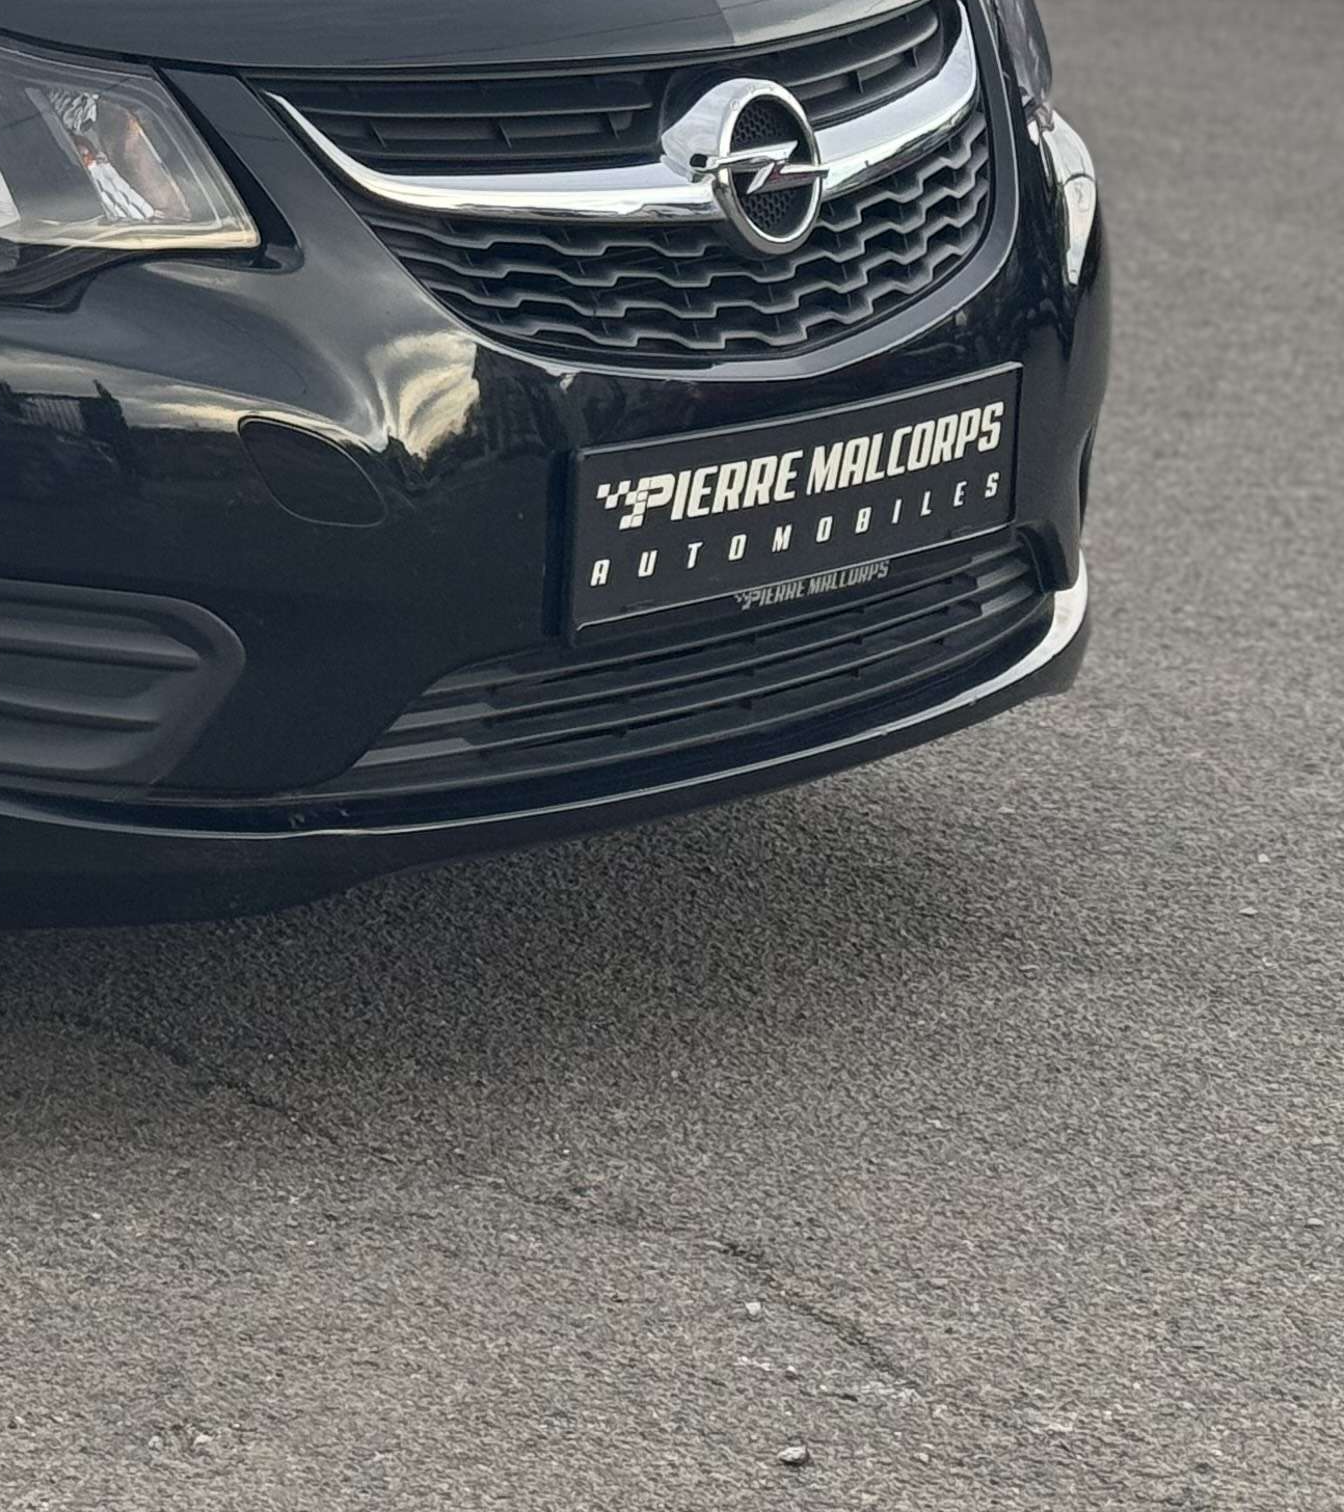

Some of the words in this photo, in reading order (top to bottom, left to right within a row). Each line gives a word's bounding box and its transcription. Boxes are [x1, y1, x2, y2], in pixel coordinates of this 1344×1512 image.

[617, 450, 804, 530] PIERRE
[806, 401, 1004, 497] MALCORPS
[590, 471, 1000, 587] AUTOMOBILES
[742, 579, 807, 611] PIERRE
